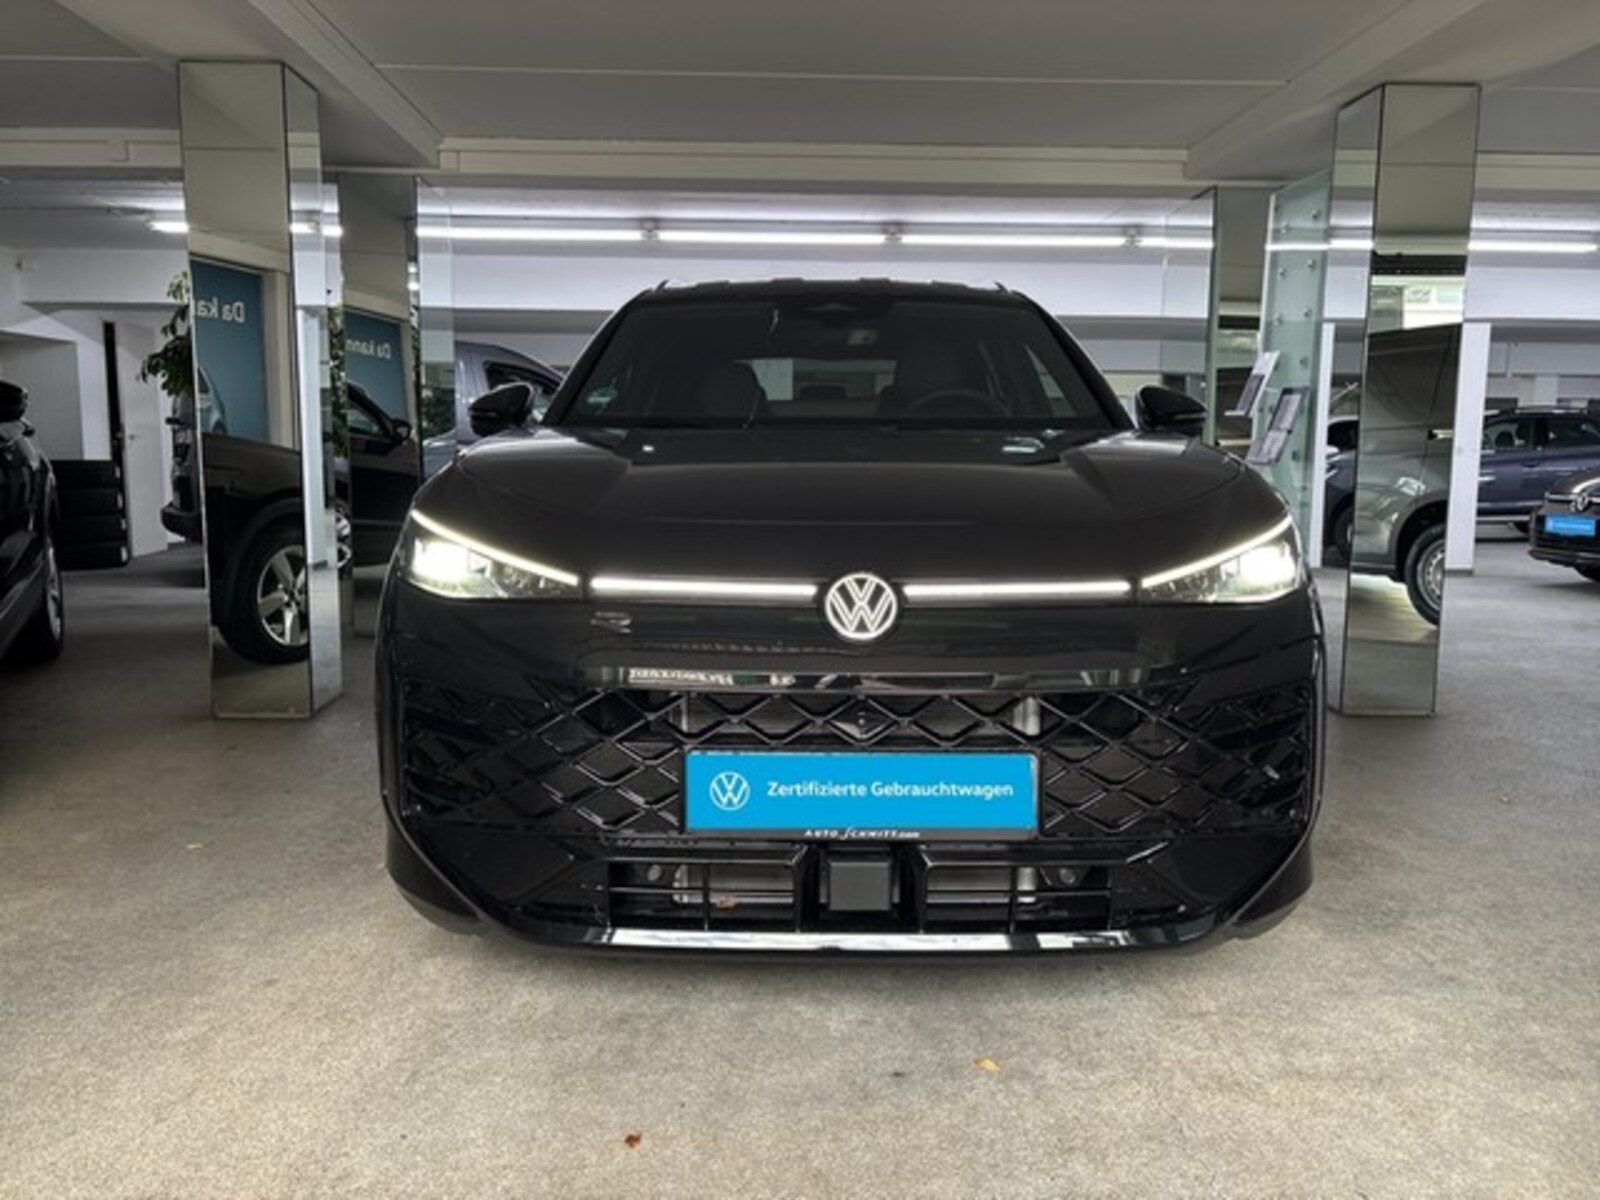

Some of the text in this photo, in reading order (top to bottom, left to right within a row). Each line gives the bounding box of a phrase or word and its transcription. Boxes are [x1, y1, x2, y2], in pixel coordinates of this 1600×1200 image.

[825, 573, 897, 640] VW
[709, 771, 750, 811] VW
[767, 781, 1014, 800] Zertifizierte Gebrauchtwagen
